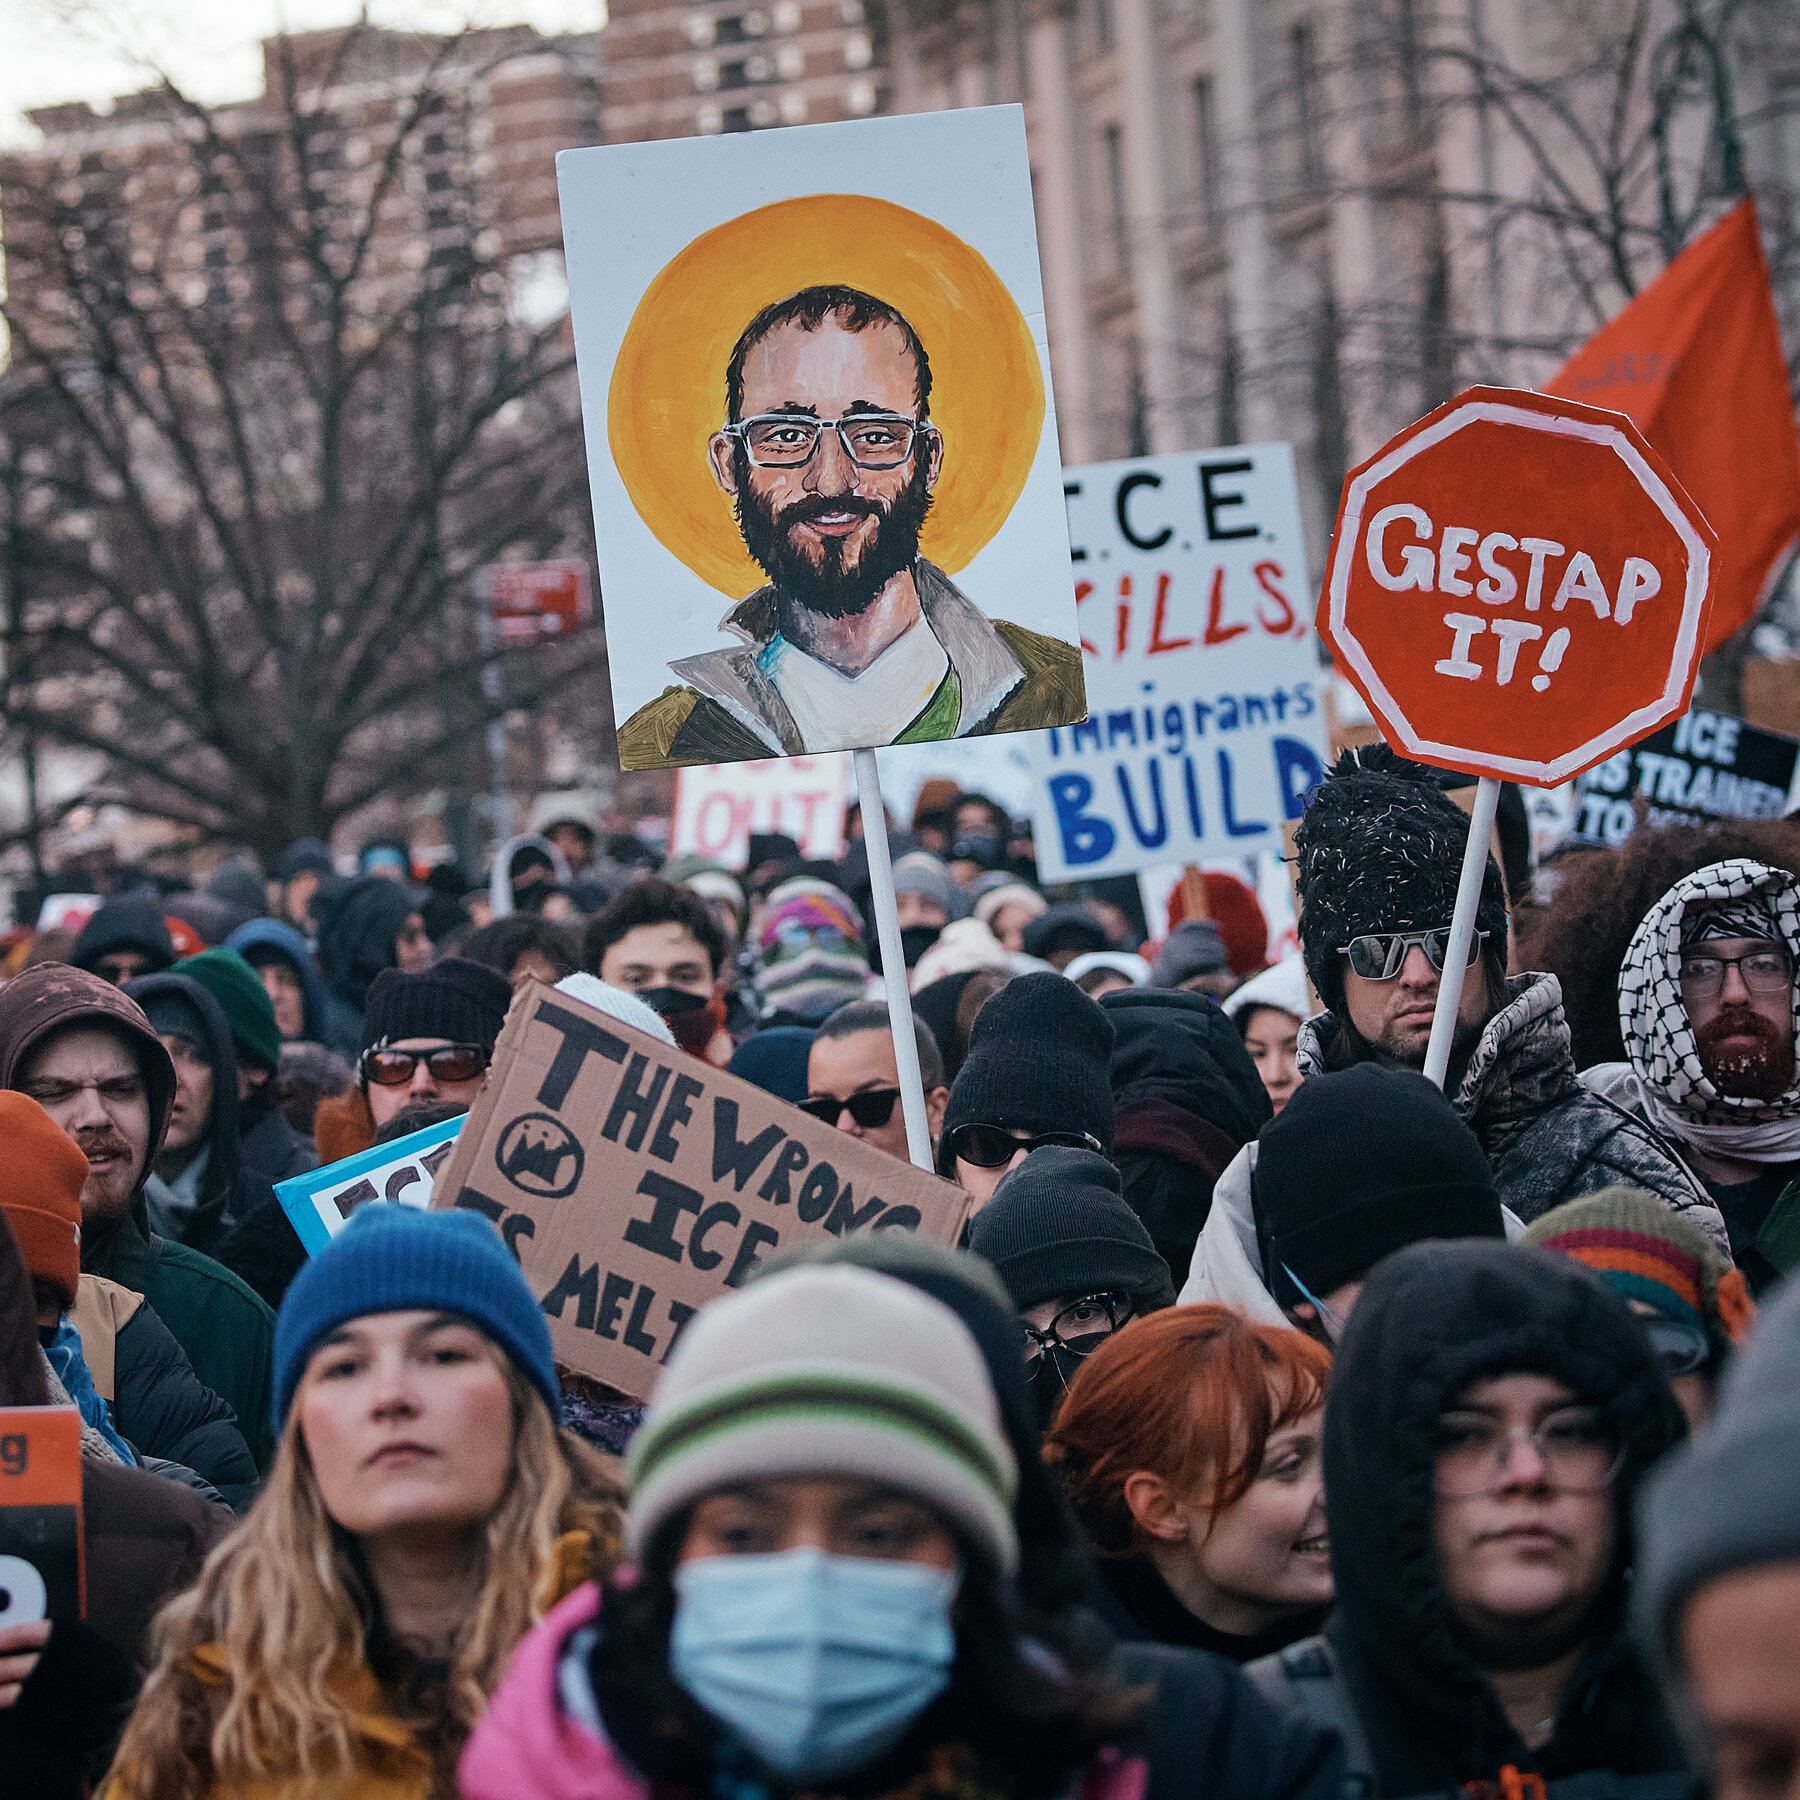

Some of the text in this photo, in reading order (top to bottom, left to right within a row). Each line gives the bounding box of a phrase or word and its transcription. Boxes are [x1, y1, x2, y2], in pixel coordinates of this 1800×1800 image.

[1366, 503, 1662, 626] GESTAP
[1434, 612, 1571, 692] IT!
[1672, 710, 1742, 765] ICE
[695, 789, 830, 856] OUT
[1048, 735, 1323, 866] BUILD
[1583, 792, 1637, 848] TO
[534, 1000, 705, 1164] THE
[622, 1169, 780, 1289] ICE
